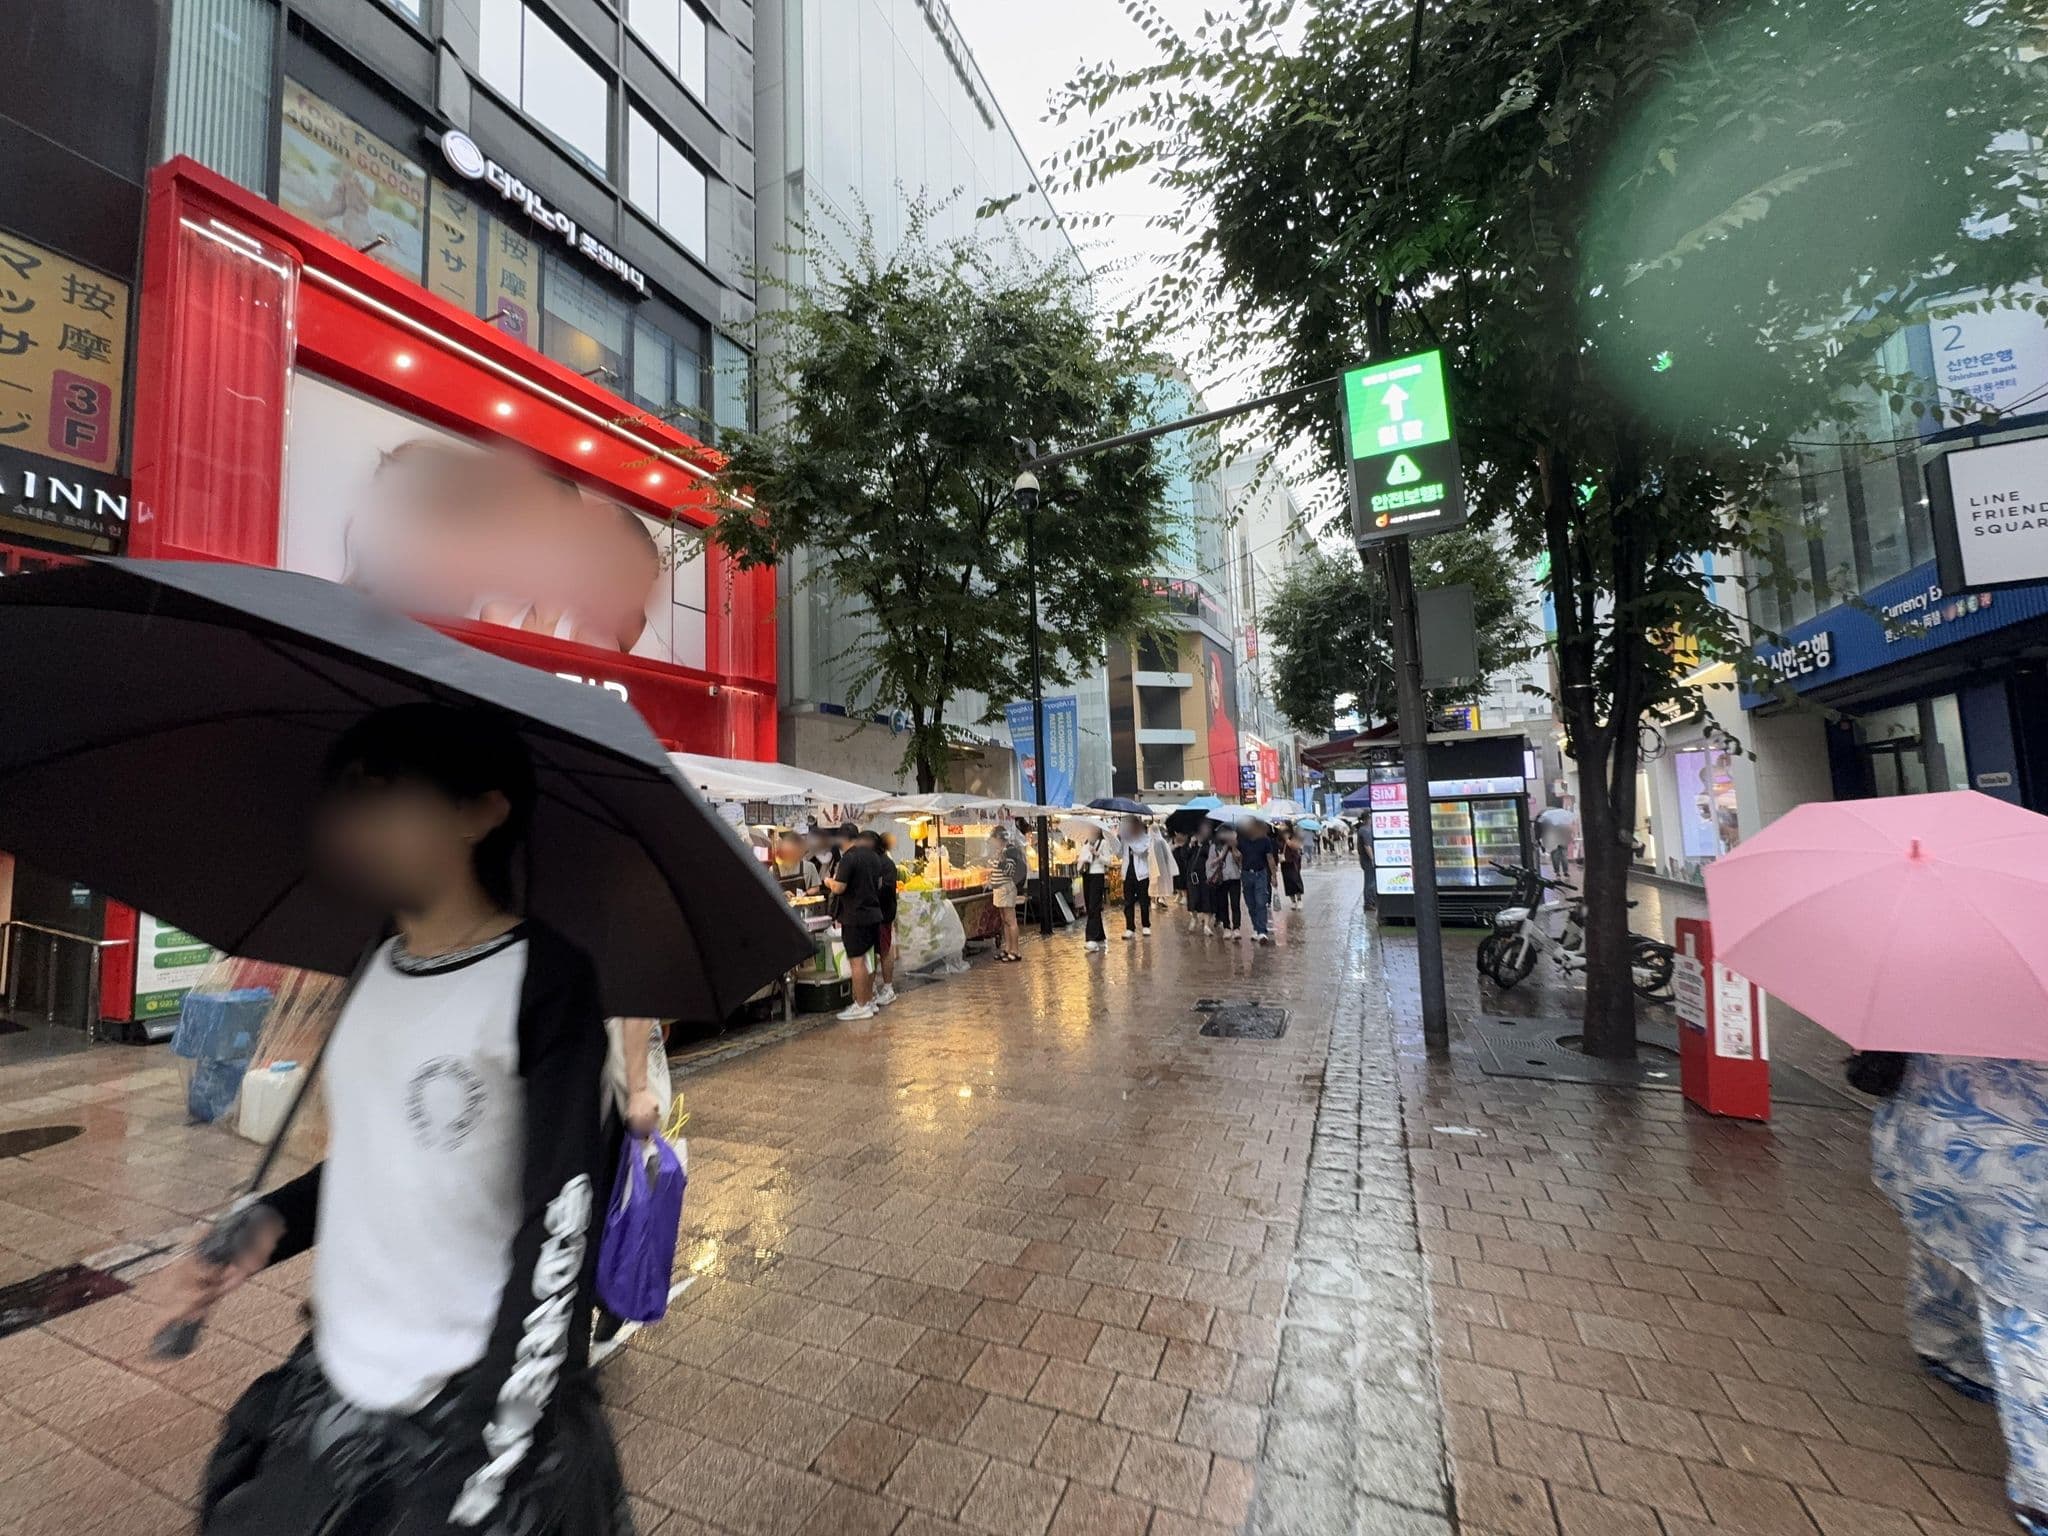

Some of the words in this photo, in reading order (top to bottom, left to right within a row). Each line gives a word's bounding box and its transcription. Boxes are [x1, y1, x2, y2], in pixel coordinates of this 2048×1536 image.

[354, 131, 413, 172] Focus
[484, 160, 576, 246] 더하노이
[579, 231, 645, 292] 풋앤바디
[500, 229, 529, 300] 按摩
[58, 272, 117, 365] 按摩
[1942, 325, 1966, 352] 2
[1946, 348, 2014, 373] 신한은행
[1947, 369, 1990, 382] Shinhan
[1991, 363, 2018, 376] Bank
[63, 382, 99, 449] 3F
[1370, 483, 1445, 513] 안전보행!
[1970, 490, 2020, 507] LINE
[1972, 502, 2048, 522] FRIEND
[1974, 517, 2048, 537] SQUAR
[1881, 591, 1928, 622] Currency
[1770, 631, 1831, 684] 신한은행
[1153, 780, 1205, 792] EIDER
[1372, 789, 1396, 801] SIM
